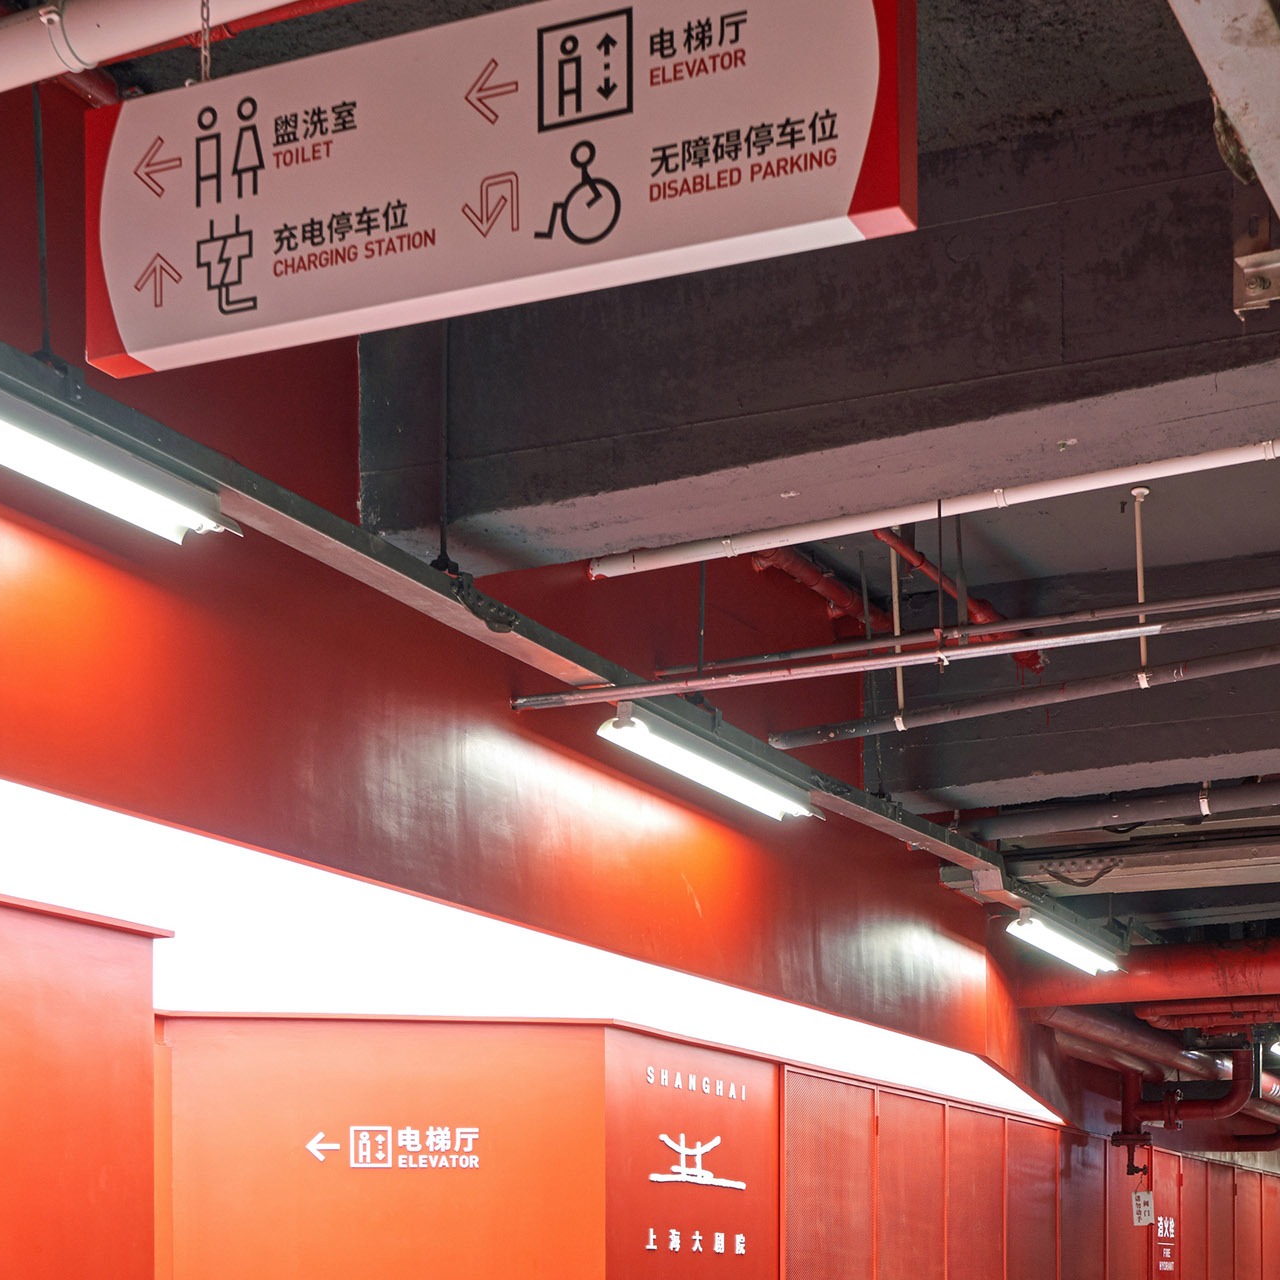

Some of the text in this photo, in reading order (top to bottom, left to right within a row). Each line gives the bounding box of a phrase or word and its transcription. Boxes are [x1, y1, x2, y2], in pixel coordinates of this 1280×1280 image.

[649, 8, 749, 60] 电梯厅
[649, 47, 747, 87] ELEVATOR
[272, 100, 358, 148] 盥洗室
[649, 108, 839, 177] 无障碍停车位
[272, 139, 334, 170] TOILET
[649, 148, 838, 203] DISABLED PARKING
[272, 200, 410, 255] 充电停车位
[272, 229, 437, 278] CHARGING STATION
[646, 1066, 746, 1101] SHANGHAI
[397, 1127, 480, 1153] 电梯厅
[398, 1155, 480, 1169] ELEVATOR
[646, 1228, 746, 1255] 上海大剧院
